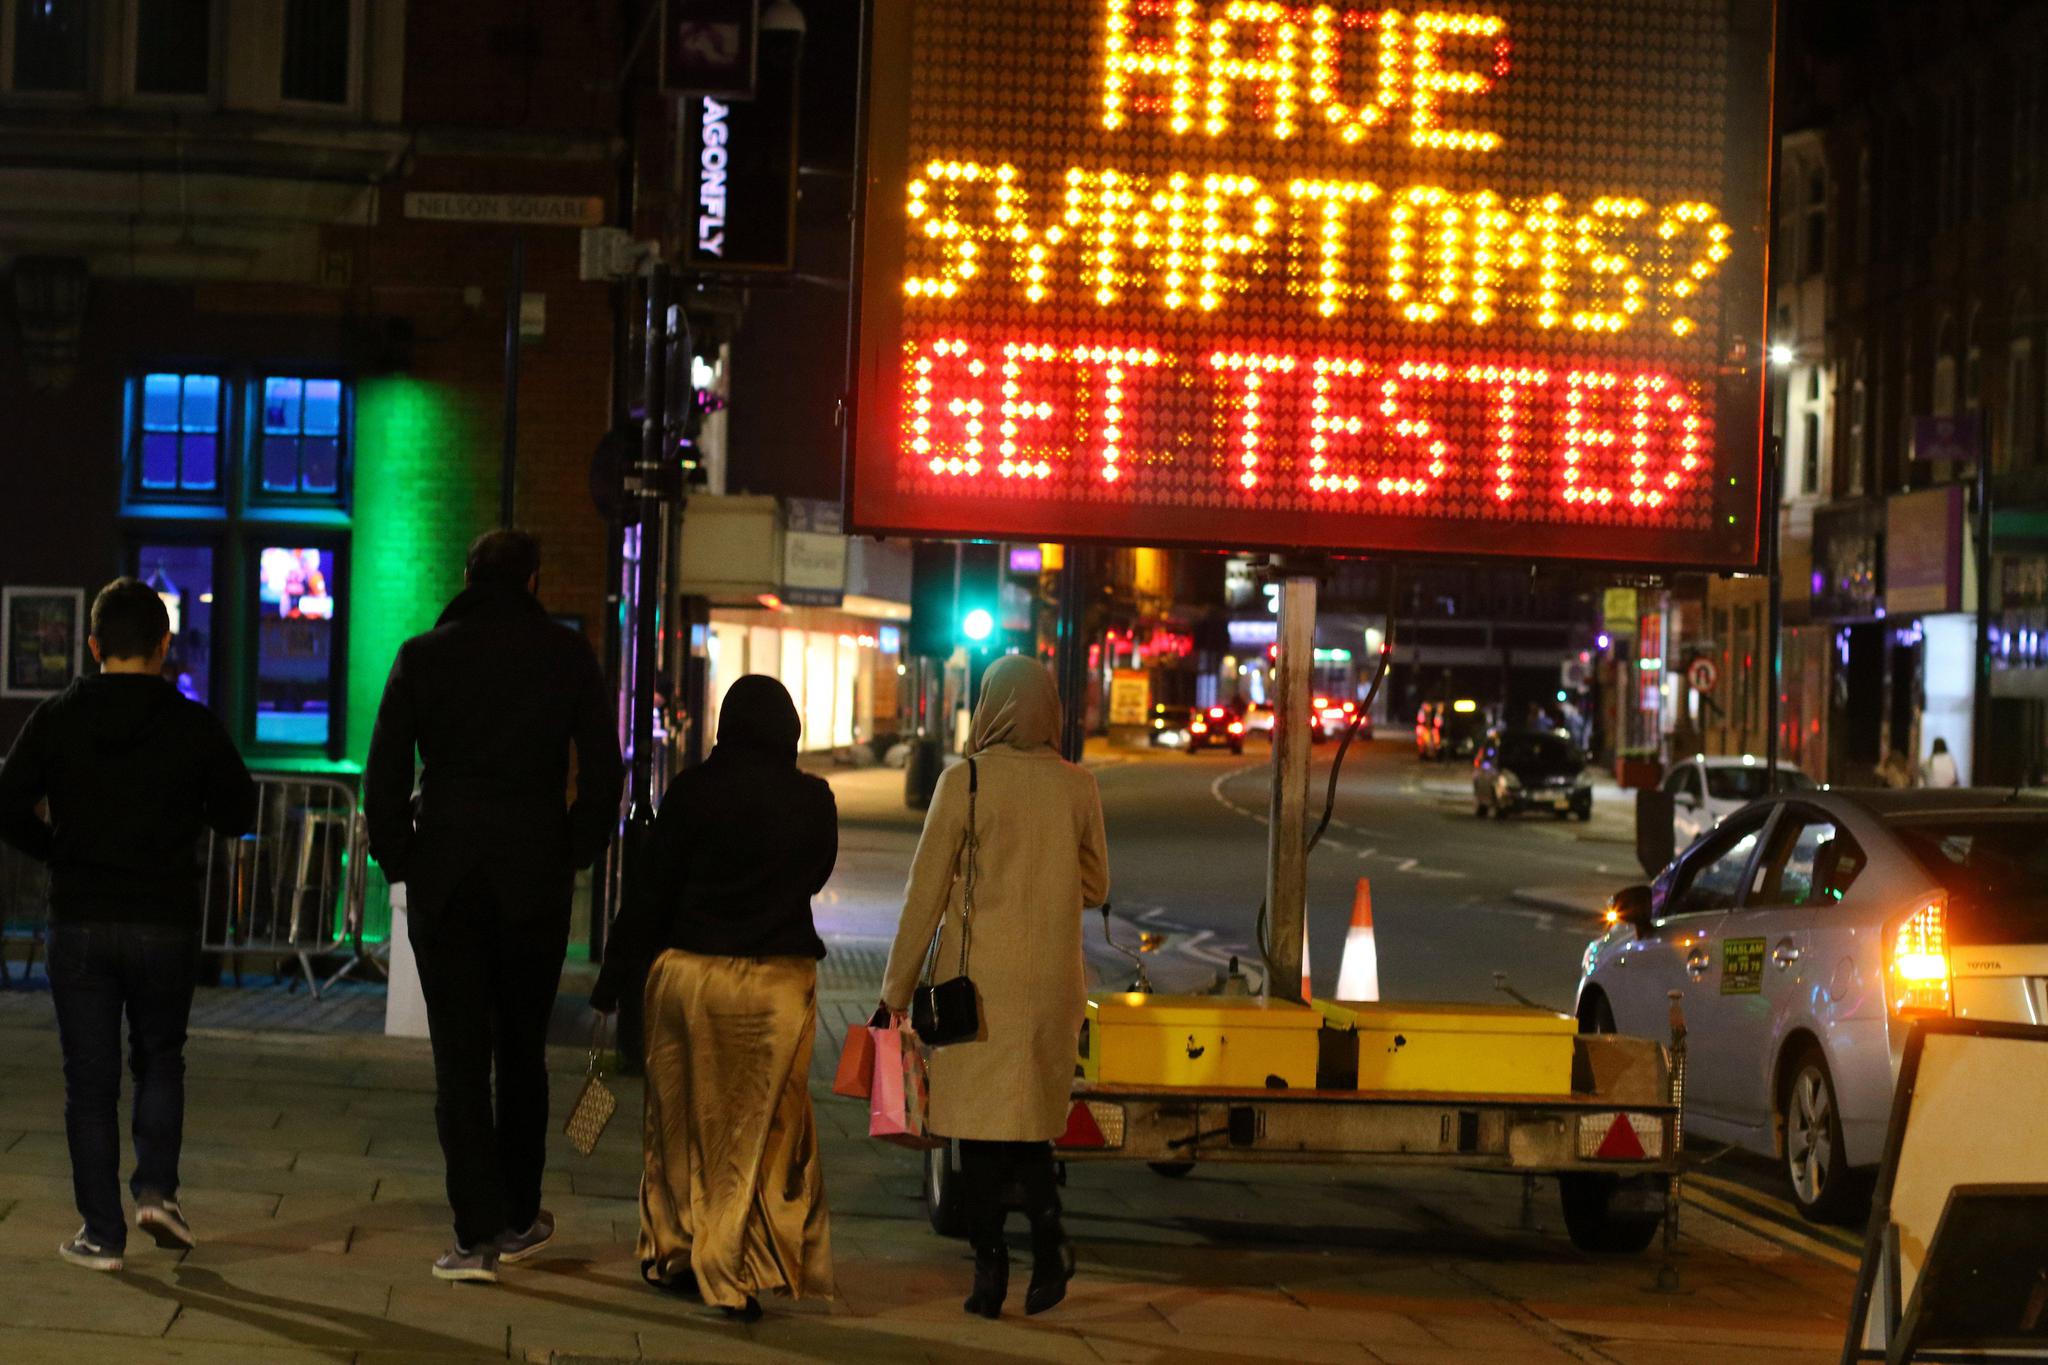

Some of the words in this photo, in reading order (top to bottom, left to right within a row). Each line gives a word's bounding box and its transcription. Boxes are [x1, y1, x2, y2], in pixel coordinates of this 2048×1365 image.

[1102, 0, 1505, 151] HAVE
[417, 196, 498, 217] NELSON
[510, 198, 590, 219] SQUARE
[700, 96, 729, 257] AGONFLY
[903, 159, 1733, 336] SYMPTOMS?
[911, 337, 1162, 486] GET
[1208, 350, 1699, 510] TESTED
[1967, 960, 2002, 970] TOYOTA
